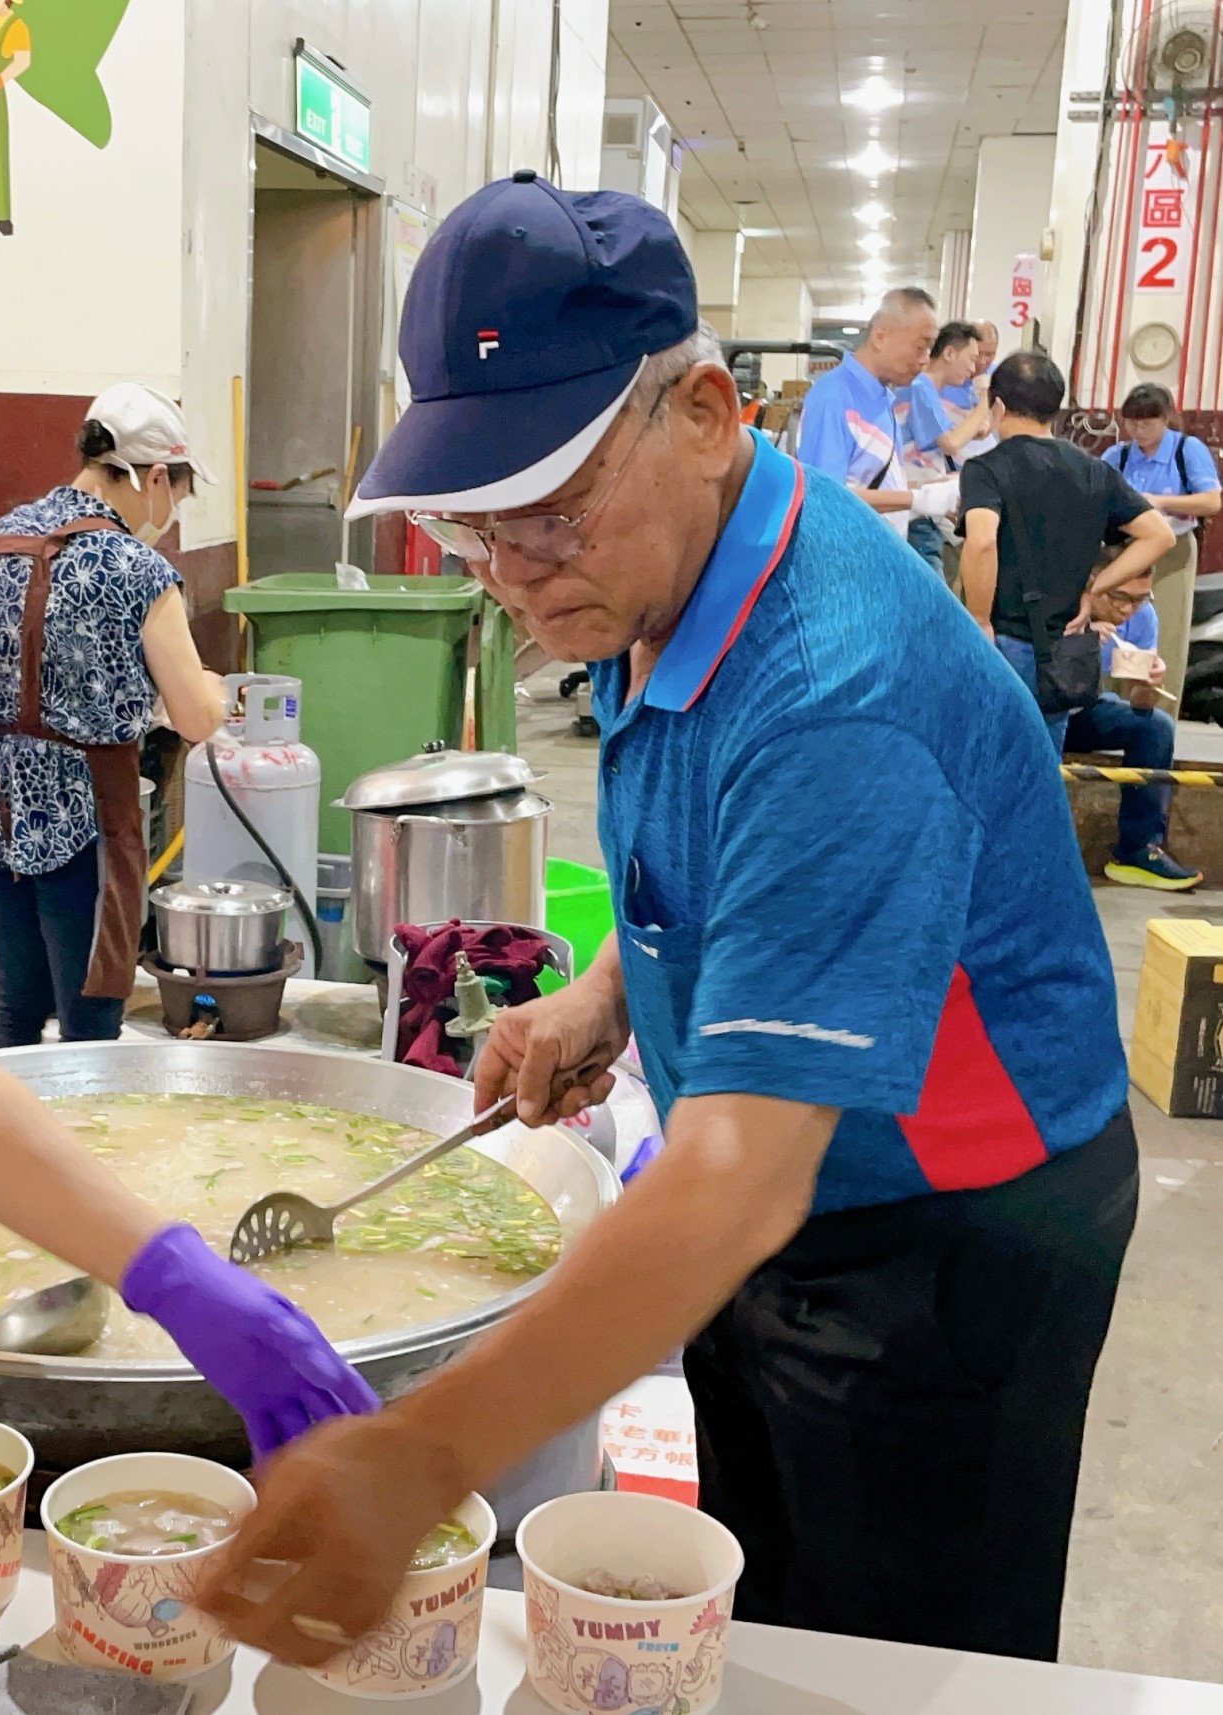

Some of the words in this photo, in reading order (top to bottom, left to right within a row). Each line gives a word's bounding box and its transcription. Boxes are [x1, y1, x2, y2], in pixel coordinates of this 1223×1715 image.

[306, 107, 327, 137] EXIT
[1137, 139, 1189, 288] 六區2
[409, 1567, 479, 1618] YUMMY
[73, 1618, 154, 1676] AMAZING
[572, 1616, 661, 1642] YUMMY
